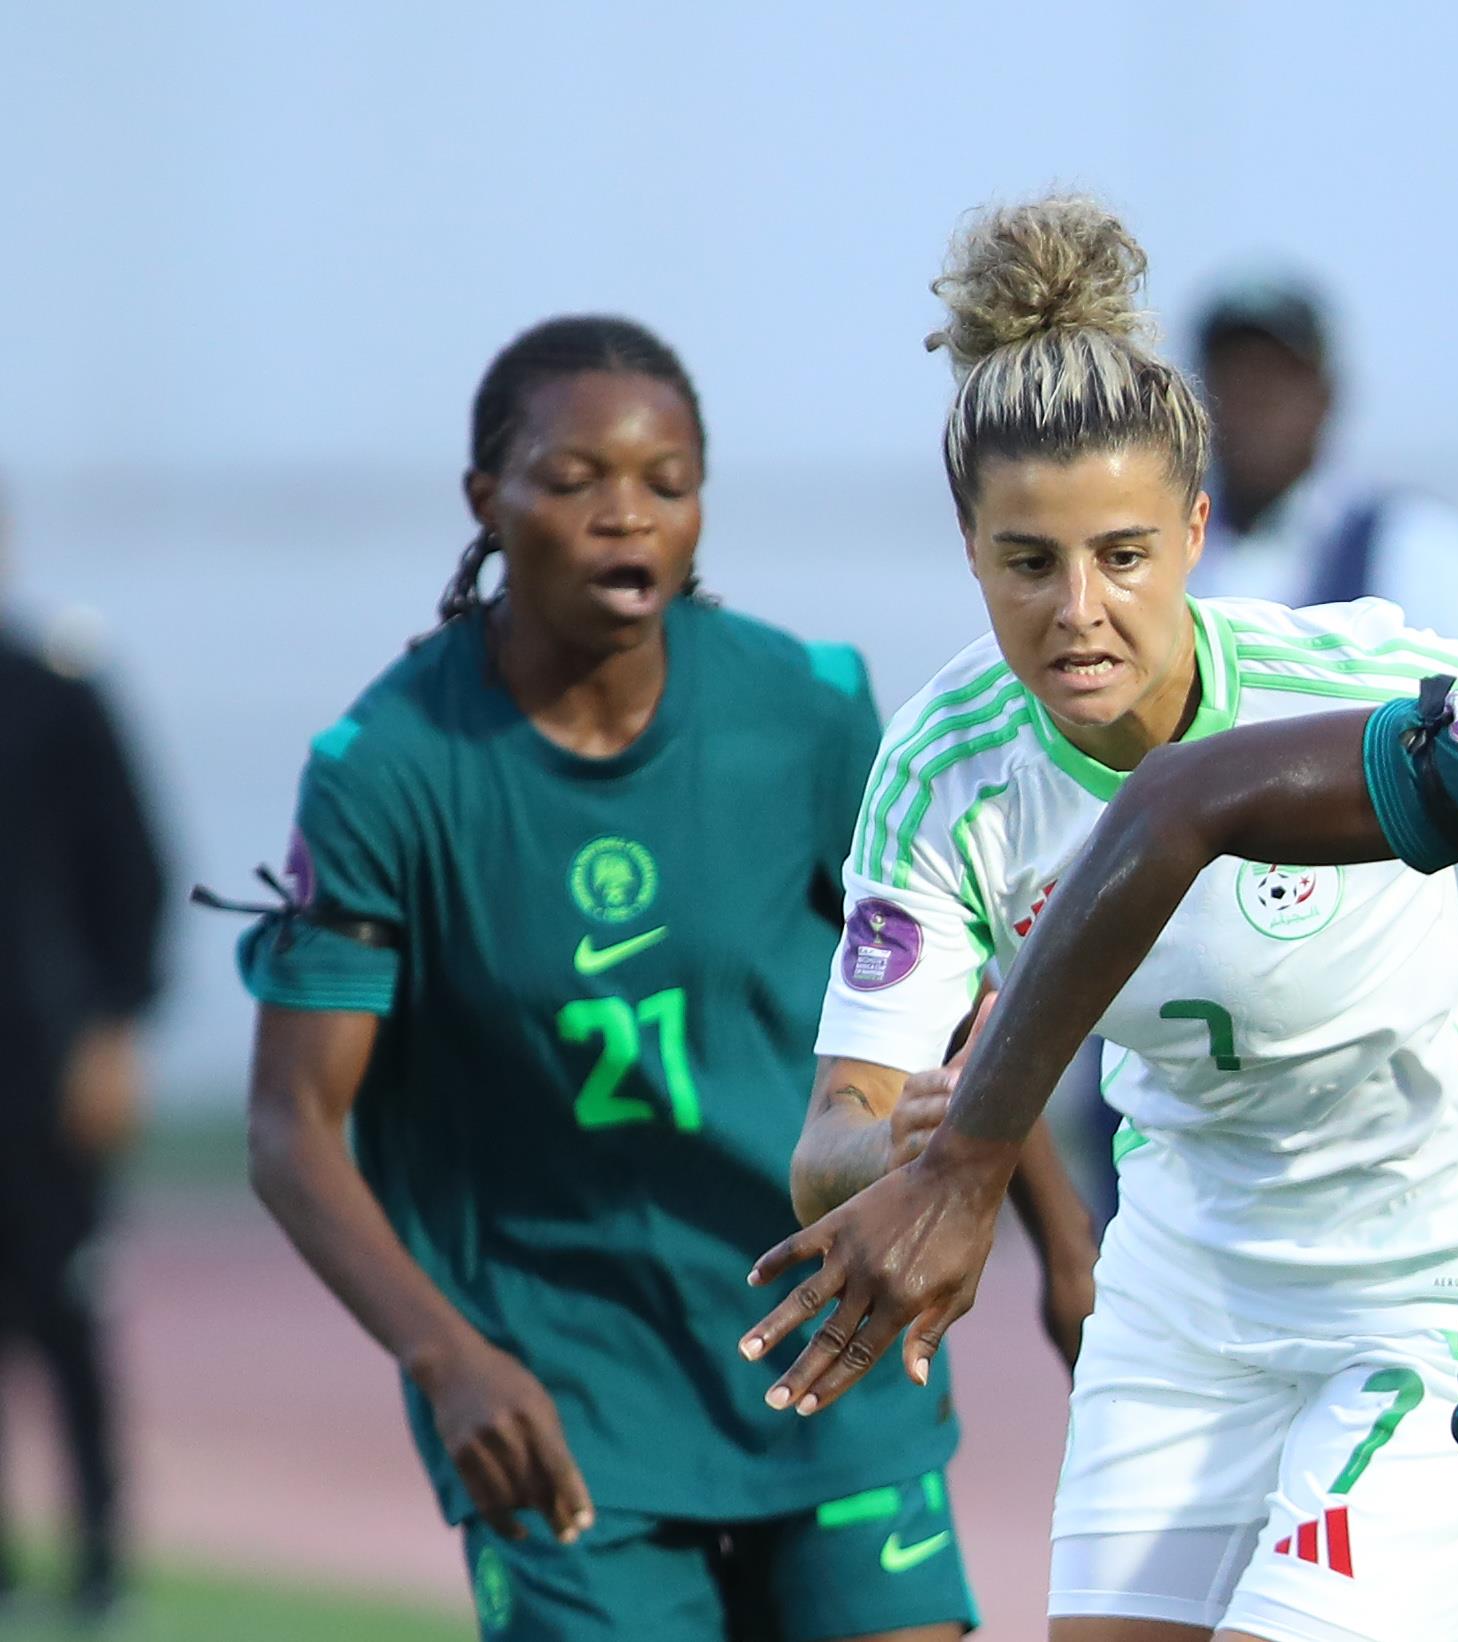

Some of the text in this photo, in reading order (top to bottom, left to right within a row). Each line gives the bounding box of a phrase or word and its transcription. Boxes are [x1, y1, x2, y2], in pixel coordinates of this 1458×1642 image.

[556, 987, 701, 1132] 21
[1159, 999, 1241, 1071] 7
[1329, 1368, 1425, 1494] 7
